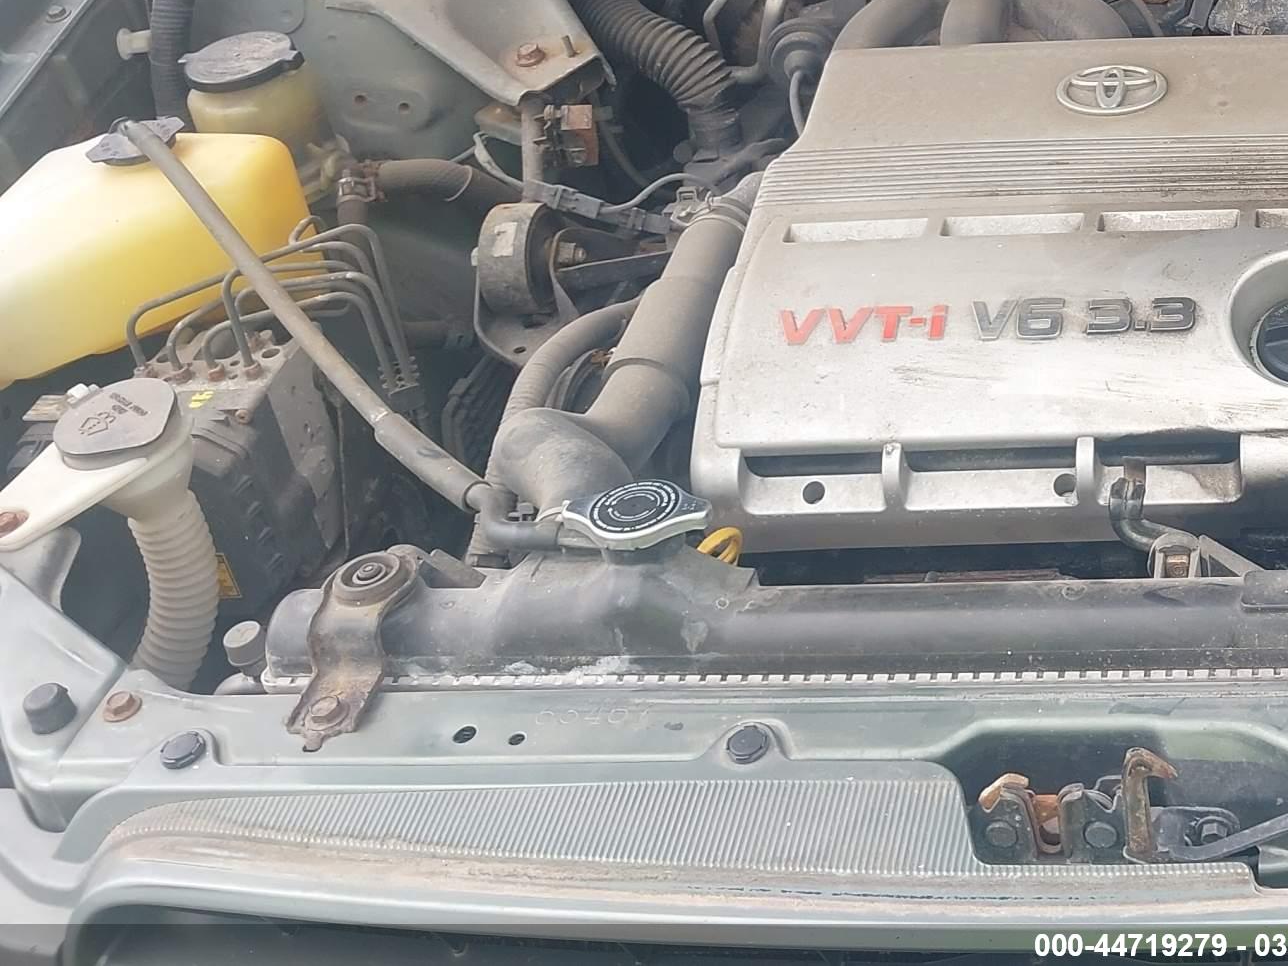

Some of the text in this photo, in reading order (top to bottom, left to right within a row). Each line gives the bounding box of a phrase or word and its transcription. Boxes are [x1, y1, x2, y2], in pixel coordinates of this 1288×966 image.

[783, 296, 1197, 346] VVT-i V6 3.3
